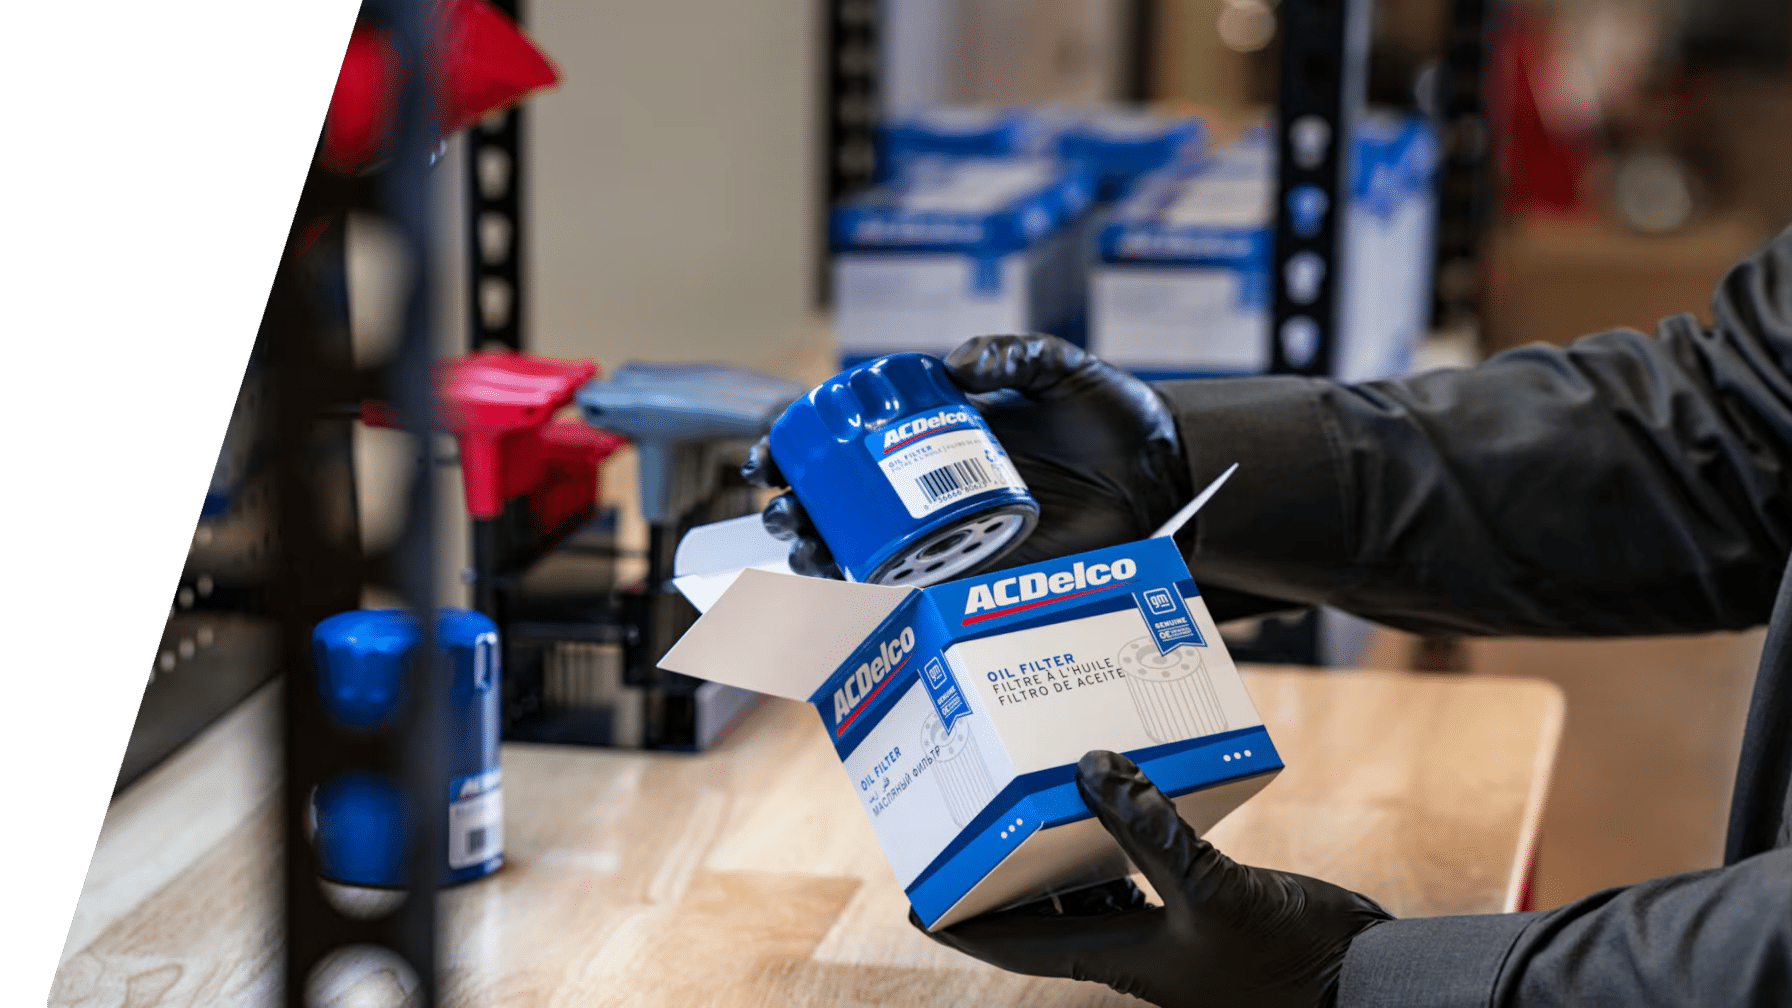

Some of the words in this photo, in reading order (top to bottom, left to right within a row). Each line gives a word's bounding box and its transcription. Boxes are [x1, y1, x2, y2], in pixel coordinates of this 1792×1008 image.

[884, 411, 967, 449] ACDelco
[903, 445, 932, 460] FILTER
[964, 558, 1138, 615] ACDelco
[1149, 594, 1170, 609] gm
[1154, 616, 1188, 629] GENUINE
[833, 626, 916, 725] ACDelco
[987, 668, 1016, 683] OIL
[1019, 653, 1076, 675] FILTER
[993, 674, 1042, 694] FILTRE
[1047, 668, 1057, 682] À
[1060, 657, 1115, 678] L'HUILE
[998, 686, 1050, 706] FILTRO
[1055, 679, 1073, 693] DE
[1078, 667, 1126, 688] ACEITE
[861, 774, 875, 791] OIL
[874, 746, 902, 778] FILTER
[872, 772, 913, 817] МАСЛЯНЫЙ
[912, 745, 940, 777] ФИЛЬТР
